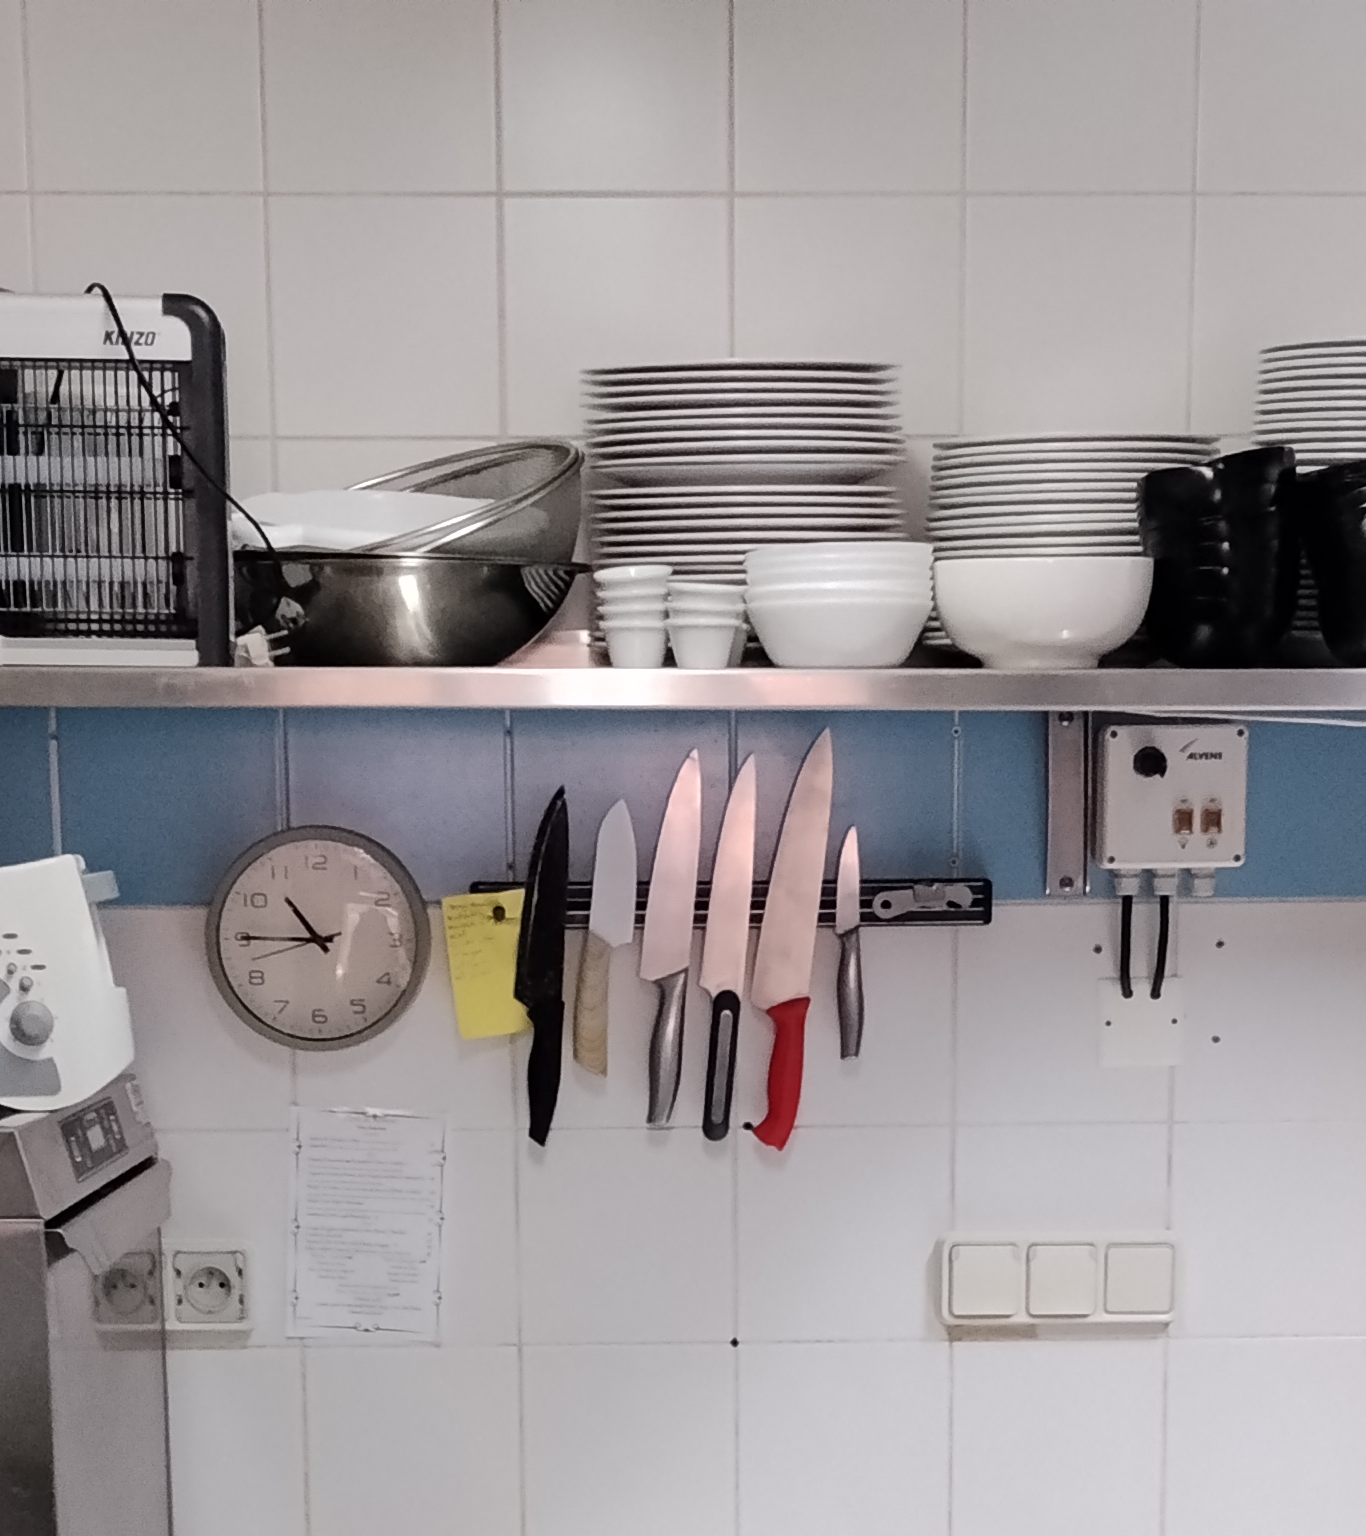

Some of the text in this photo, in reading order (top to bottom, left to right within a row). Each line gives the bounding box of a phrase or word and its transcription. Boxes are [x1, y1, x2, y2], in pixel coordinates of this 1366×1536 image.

[304, 854, 328, 871] 12
[271, 864, 289, 880] 11
[242, 891, 268, 909] 10
[374, 890, 392, 908] 2
[248, 969, 265, 986] 8
[375, 971, 393, 986] 4
[273, 999, 290, 1015] 7
[349, 998, 367, 1015] 5
[311, 1008, 329, 1025] 6
